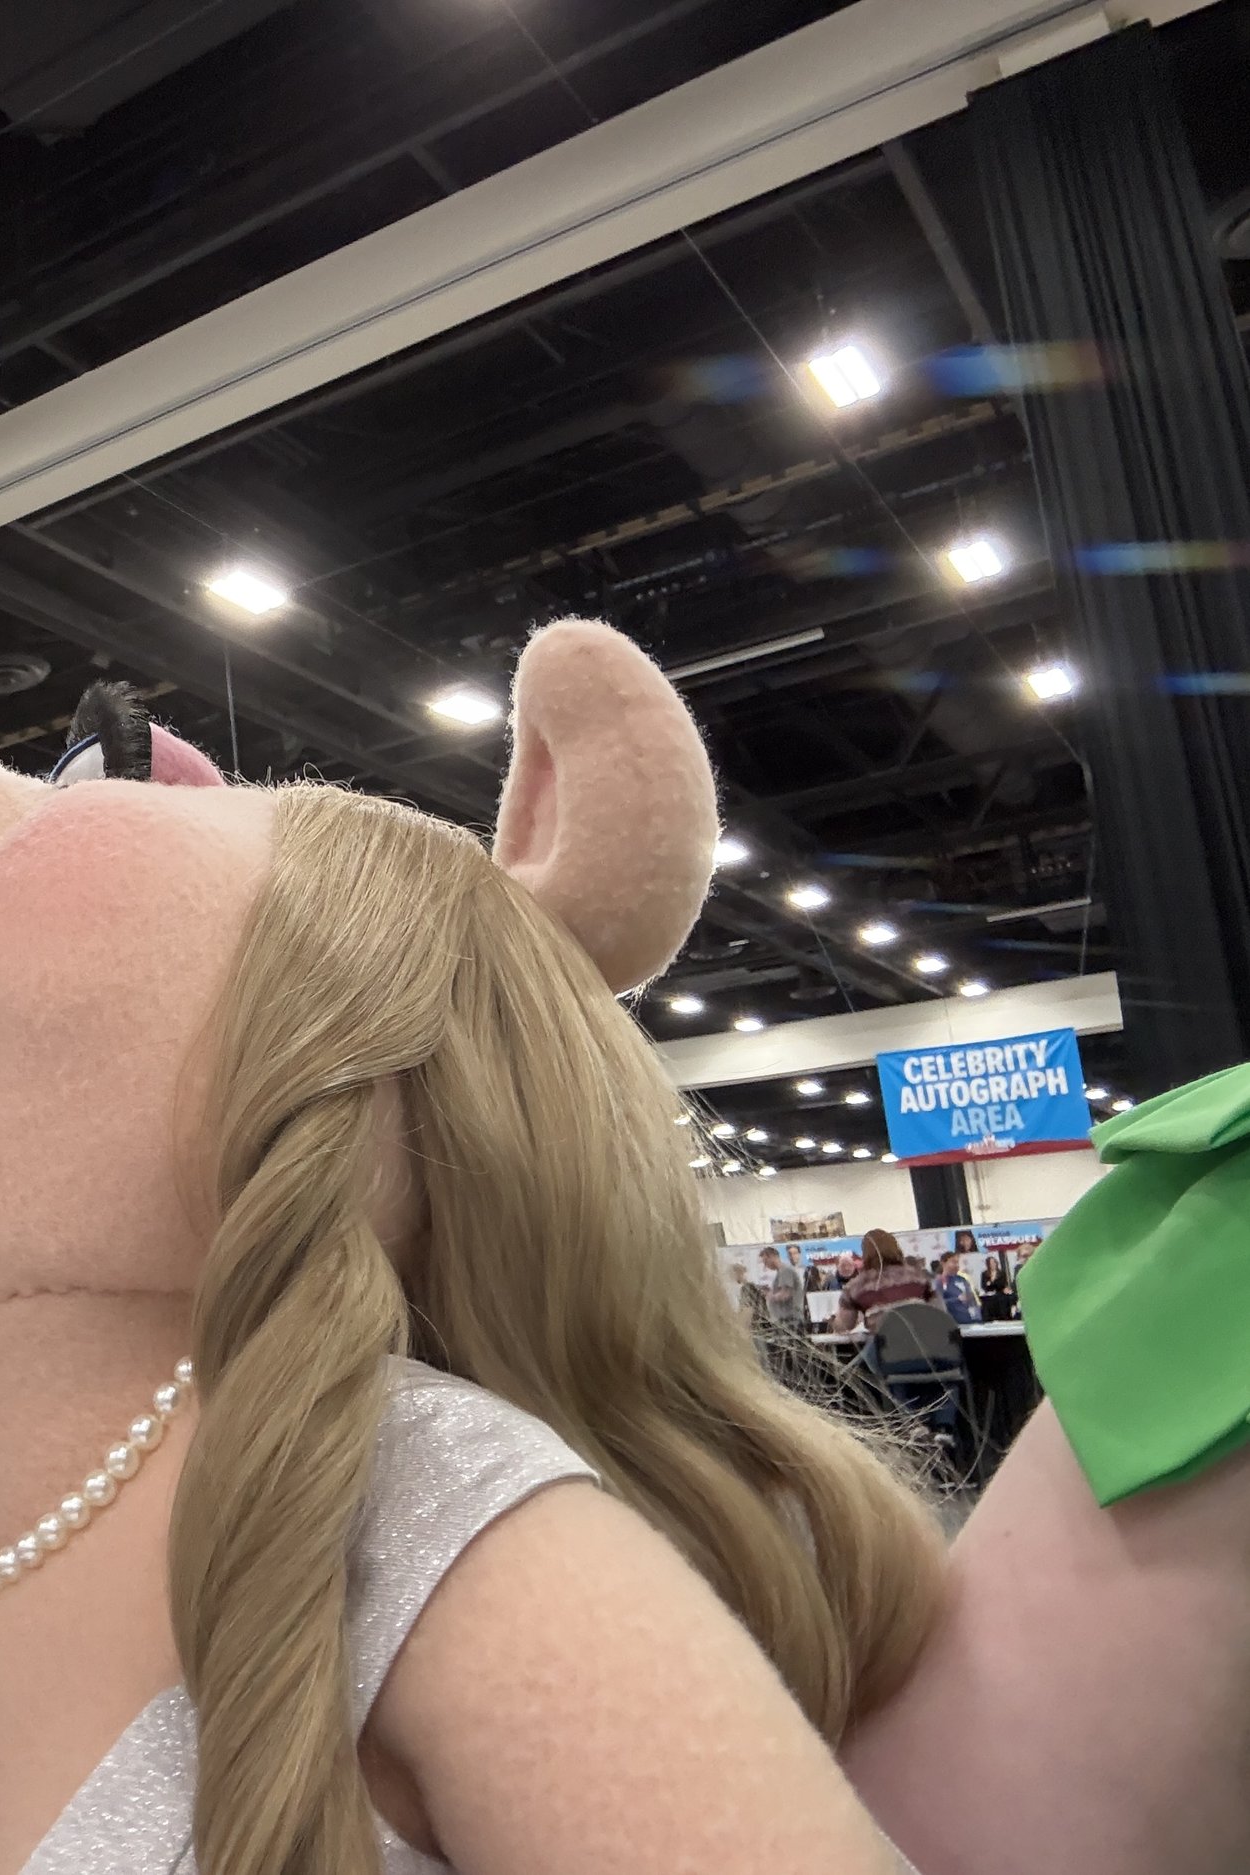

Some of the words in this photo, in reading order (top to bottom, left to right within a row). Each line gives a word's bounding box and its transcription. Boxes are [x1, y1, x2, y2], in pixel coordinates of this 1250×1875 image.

[903, 1039, 1049, 1084] CELEBRITY
[900, 1066, 1069, 1114] AUTOGRAPH
[951, 1103, 1025, 1136] AREA
